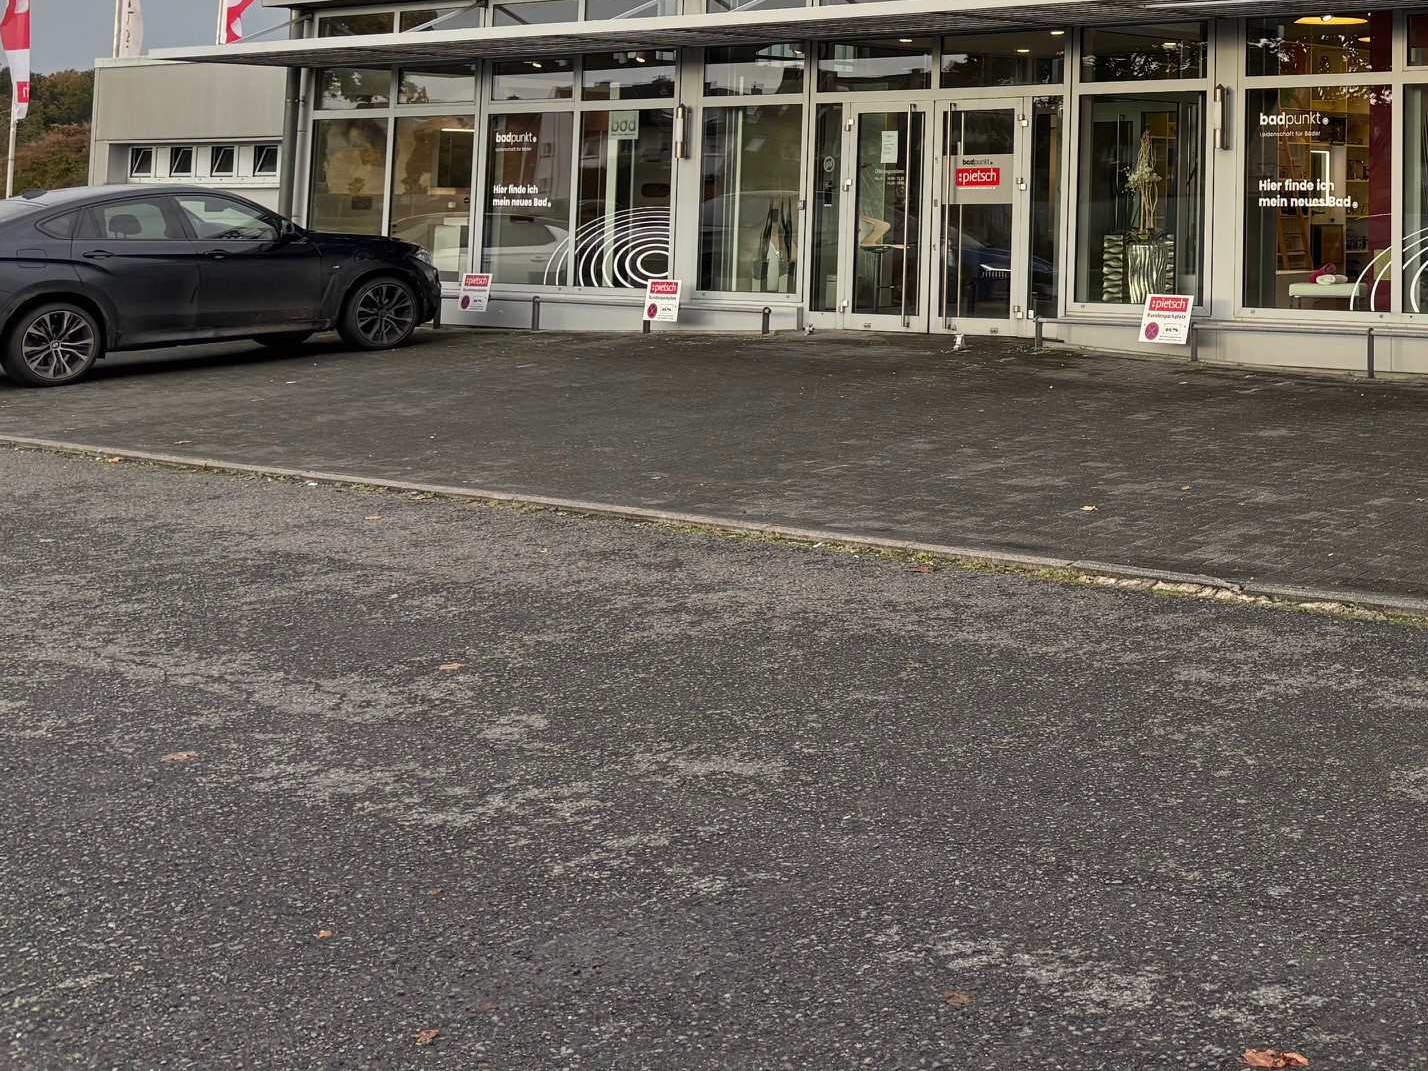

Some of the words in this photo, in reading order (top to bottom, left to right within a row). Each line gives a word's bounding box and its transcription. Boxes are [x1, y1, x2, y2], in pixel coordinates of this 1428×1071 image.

[493, 184, 508, 194] Hier
[508, 184, 526, 194] finde
[527, 184, 539, 194] ich
[1258, 178, 1283, 191] Hier
[1284, 178, 1315, 191] finde
[1316, 178, 1335, 191] ich
[492, 196, 511, 207] mein
[511, 198, 533, 207] neues
[1258, 194, 1288, 207] mein
[1290, 196, 1324, 207] neues
